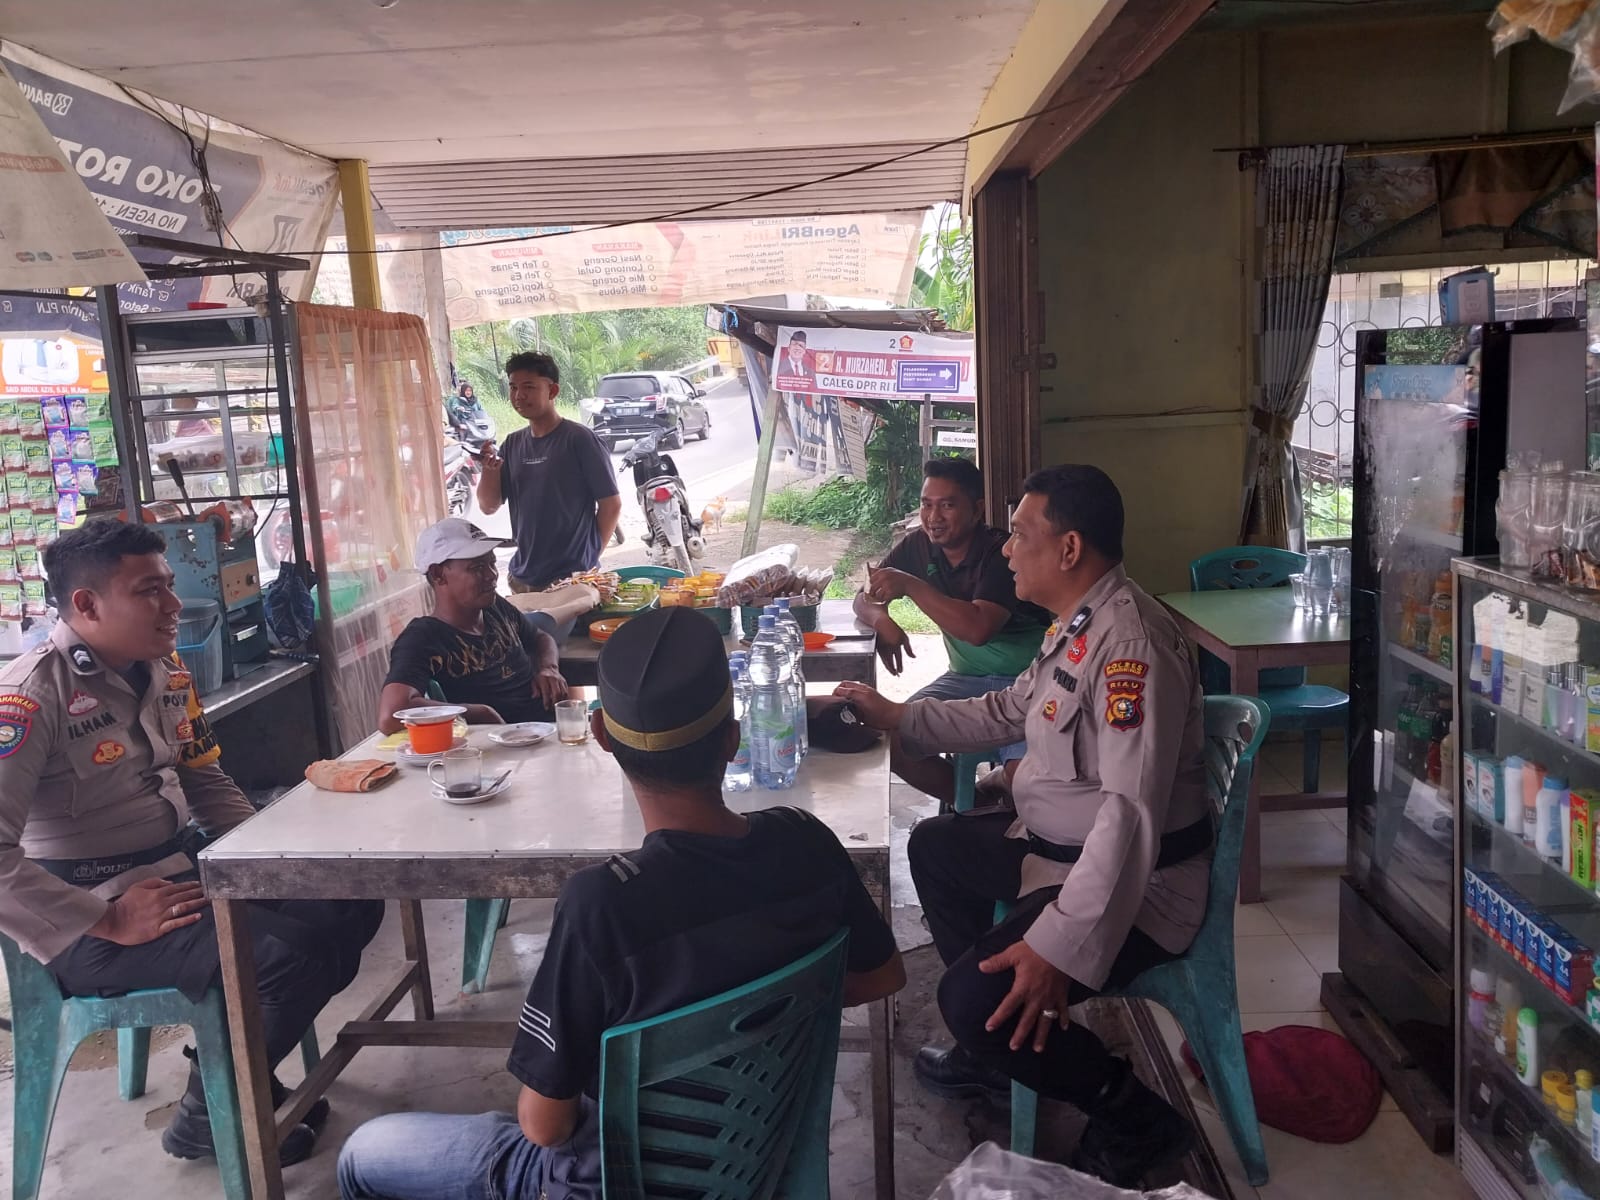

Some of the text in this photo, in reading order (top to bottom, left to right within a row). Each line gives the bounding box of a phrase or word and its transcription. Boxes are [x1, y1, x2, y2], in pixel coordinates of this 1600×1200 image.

[889, 338, 896, 349] 2
[822, 376, 855, 390] CALEG
[856, 379, 877, 391] DPR
[880, 380, 890, 391] RI
[1106, 661, 1144, 672] POLRES
[1110, 681, 1139, 689] RIAU
[67, 711, 117, 740] ILHAM
